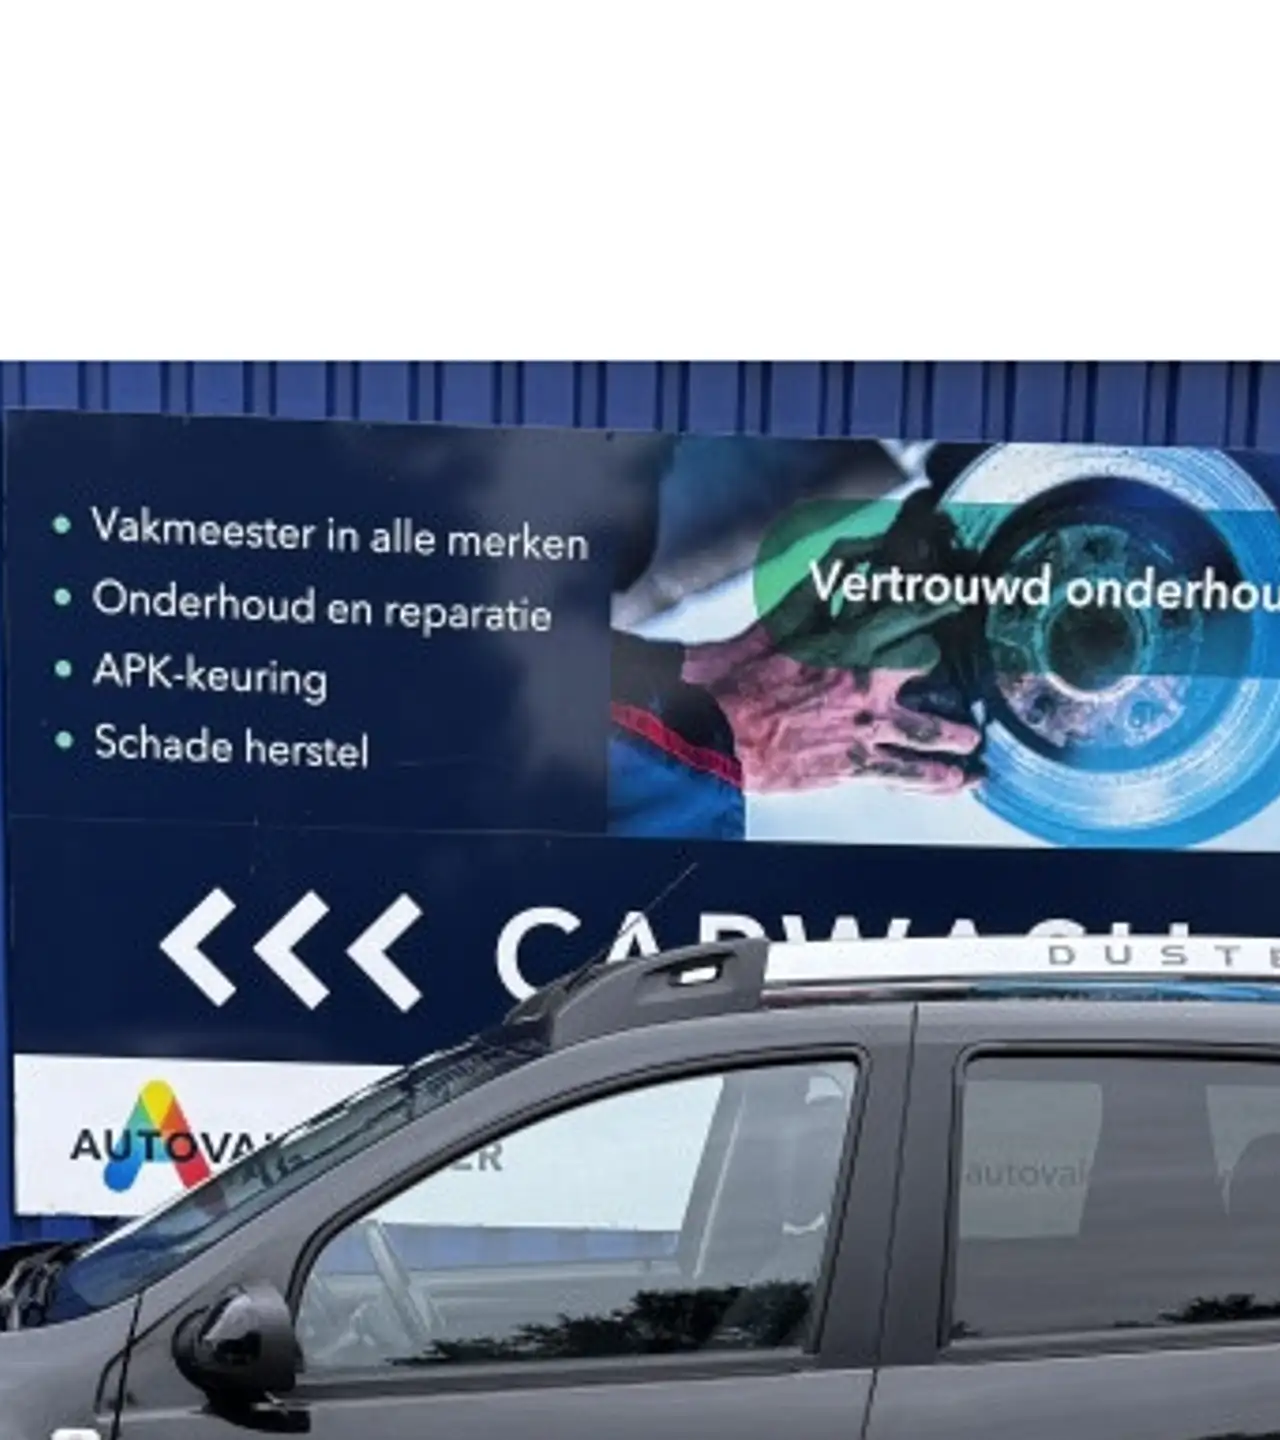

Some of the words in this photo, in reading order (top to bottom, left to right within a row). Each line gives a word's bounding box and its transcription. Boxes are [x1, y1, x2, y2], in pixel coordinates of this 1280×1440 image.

[91, 505, 316, 550] Vakmeester
[327, 517, 358, 550] in
[371, 518, 436, 555] alle
[448, 521, 587, 560] merken
[92, 578, 316, 624] Onderhoud
[328, 600, 372, 625] en
[386, 602, 552, 637] reparatie
[808, 560, 1051, 607] Vertrouwd
[93, 651, 327, 706] APK-keuring
[95, 722, 233, 764] Schade
[245, 728, 369, 768] herstel
[70, 1128, 276, 1163] AUTOVA
